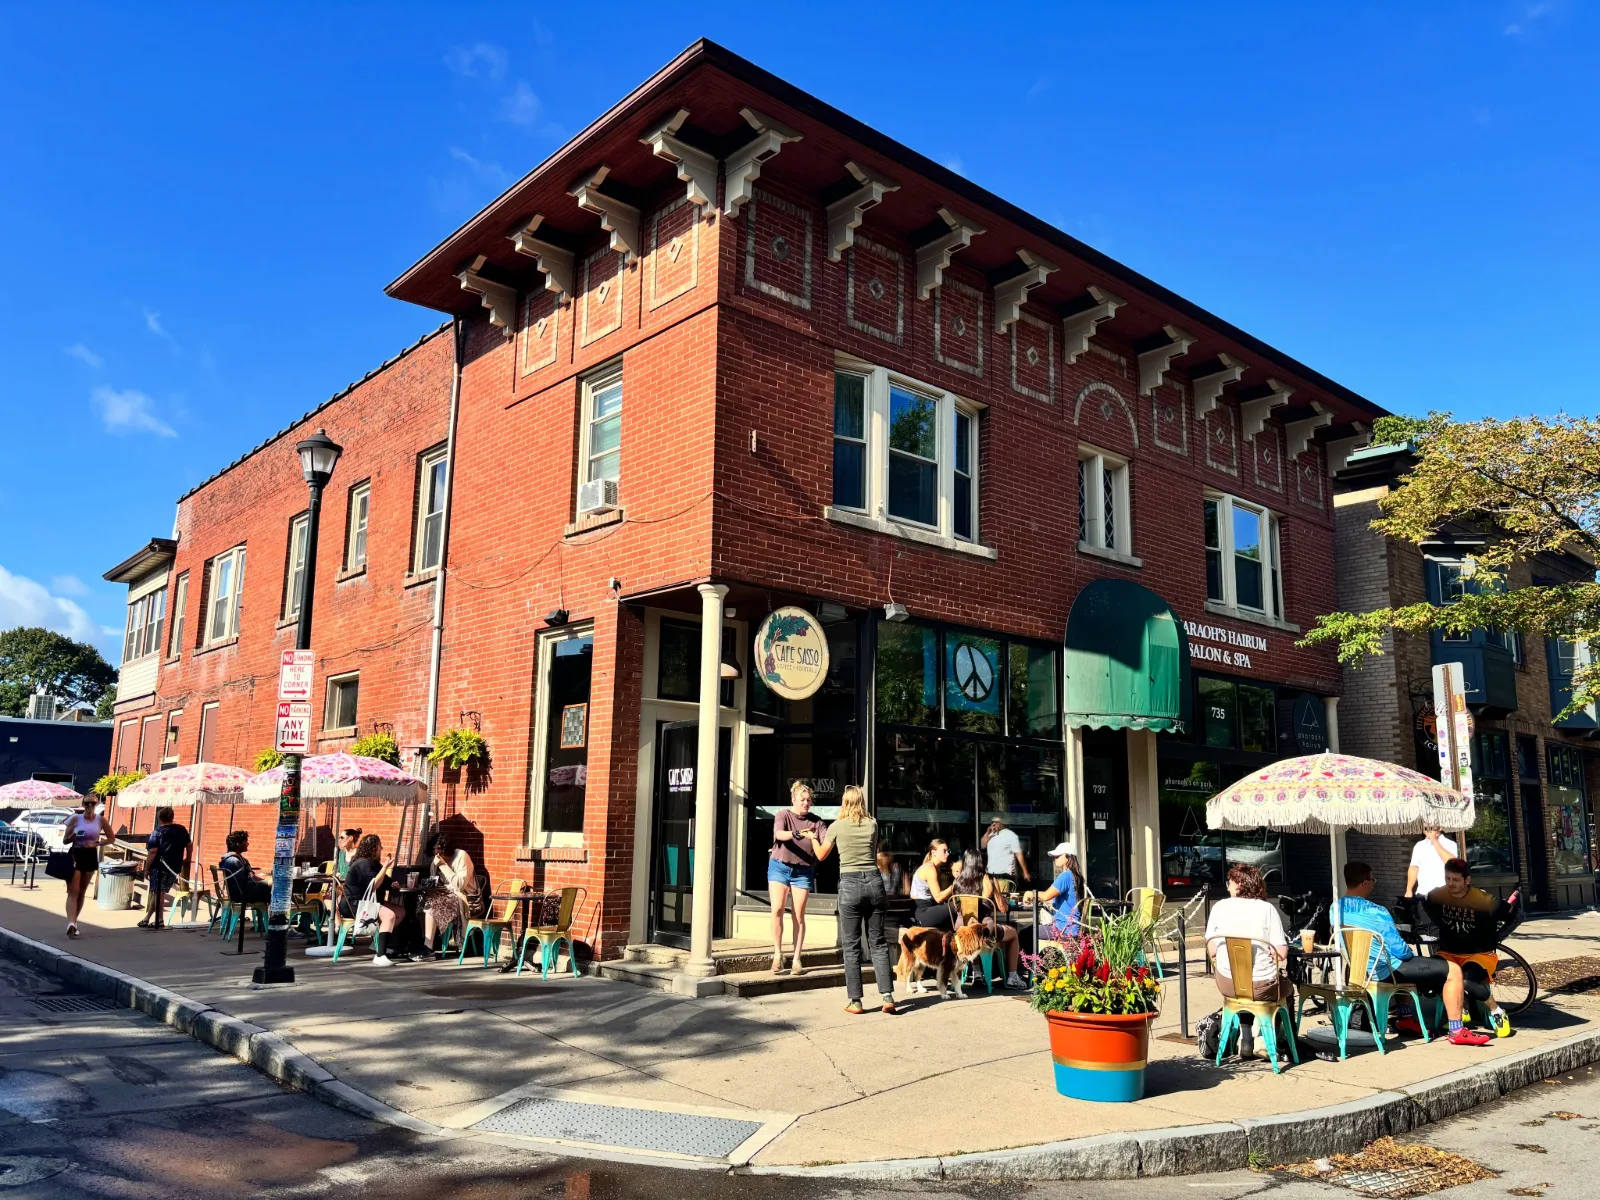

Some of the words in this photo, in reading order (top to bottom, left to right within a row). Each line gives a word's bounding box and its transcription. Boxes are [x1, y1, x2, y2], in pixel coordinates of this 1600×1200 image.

[1184, 621, 1226, 642] ARAOH'S
[1228, 631, 1267, 651] HAIRUM
[283, 652, 294, 663] NO
[294, 653, 313, 662] STANDING
[775, 644, 796, 664] CAFE
[797, 647, 820, 666] SASSO
[1188, 642, 1221, 662] SALON
[1222, 650, 1232, 665] &
[1233, 652, 1252, 668] SPA
[293, 673, 301, 681] TO
[279, 705, 290, 716] NO
[290, 706, 310, 714] PARKING
[1211, 706, 1226, 720] 735
[283, 719, 304, 730] ANY
[280, 730, 306, 741] TIME
[1423, 739, 1438, 751] ICE
[1092, 784, 1107, 794] 737
